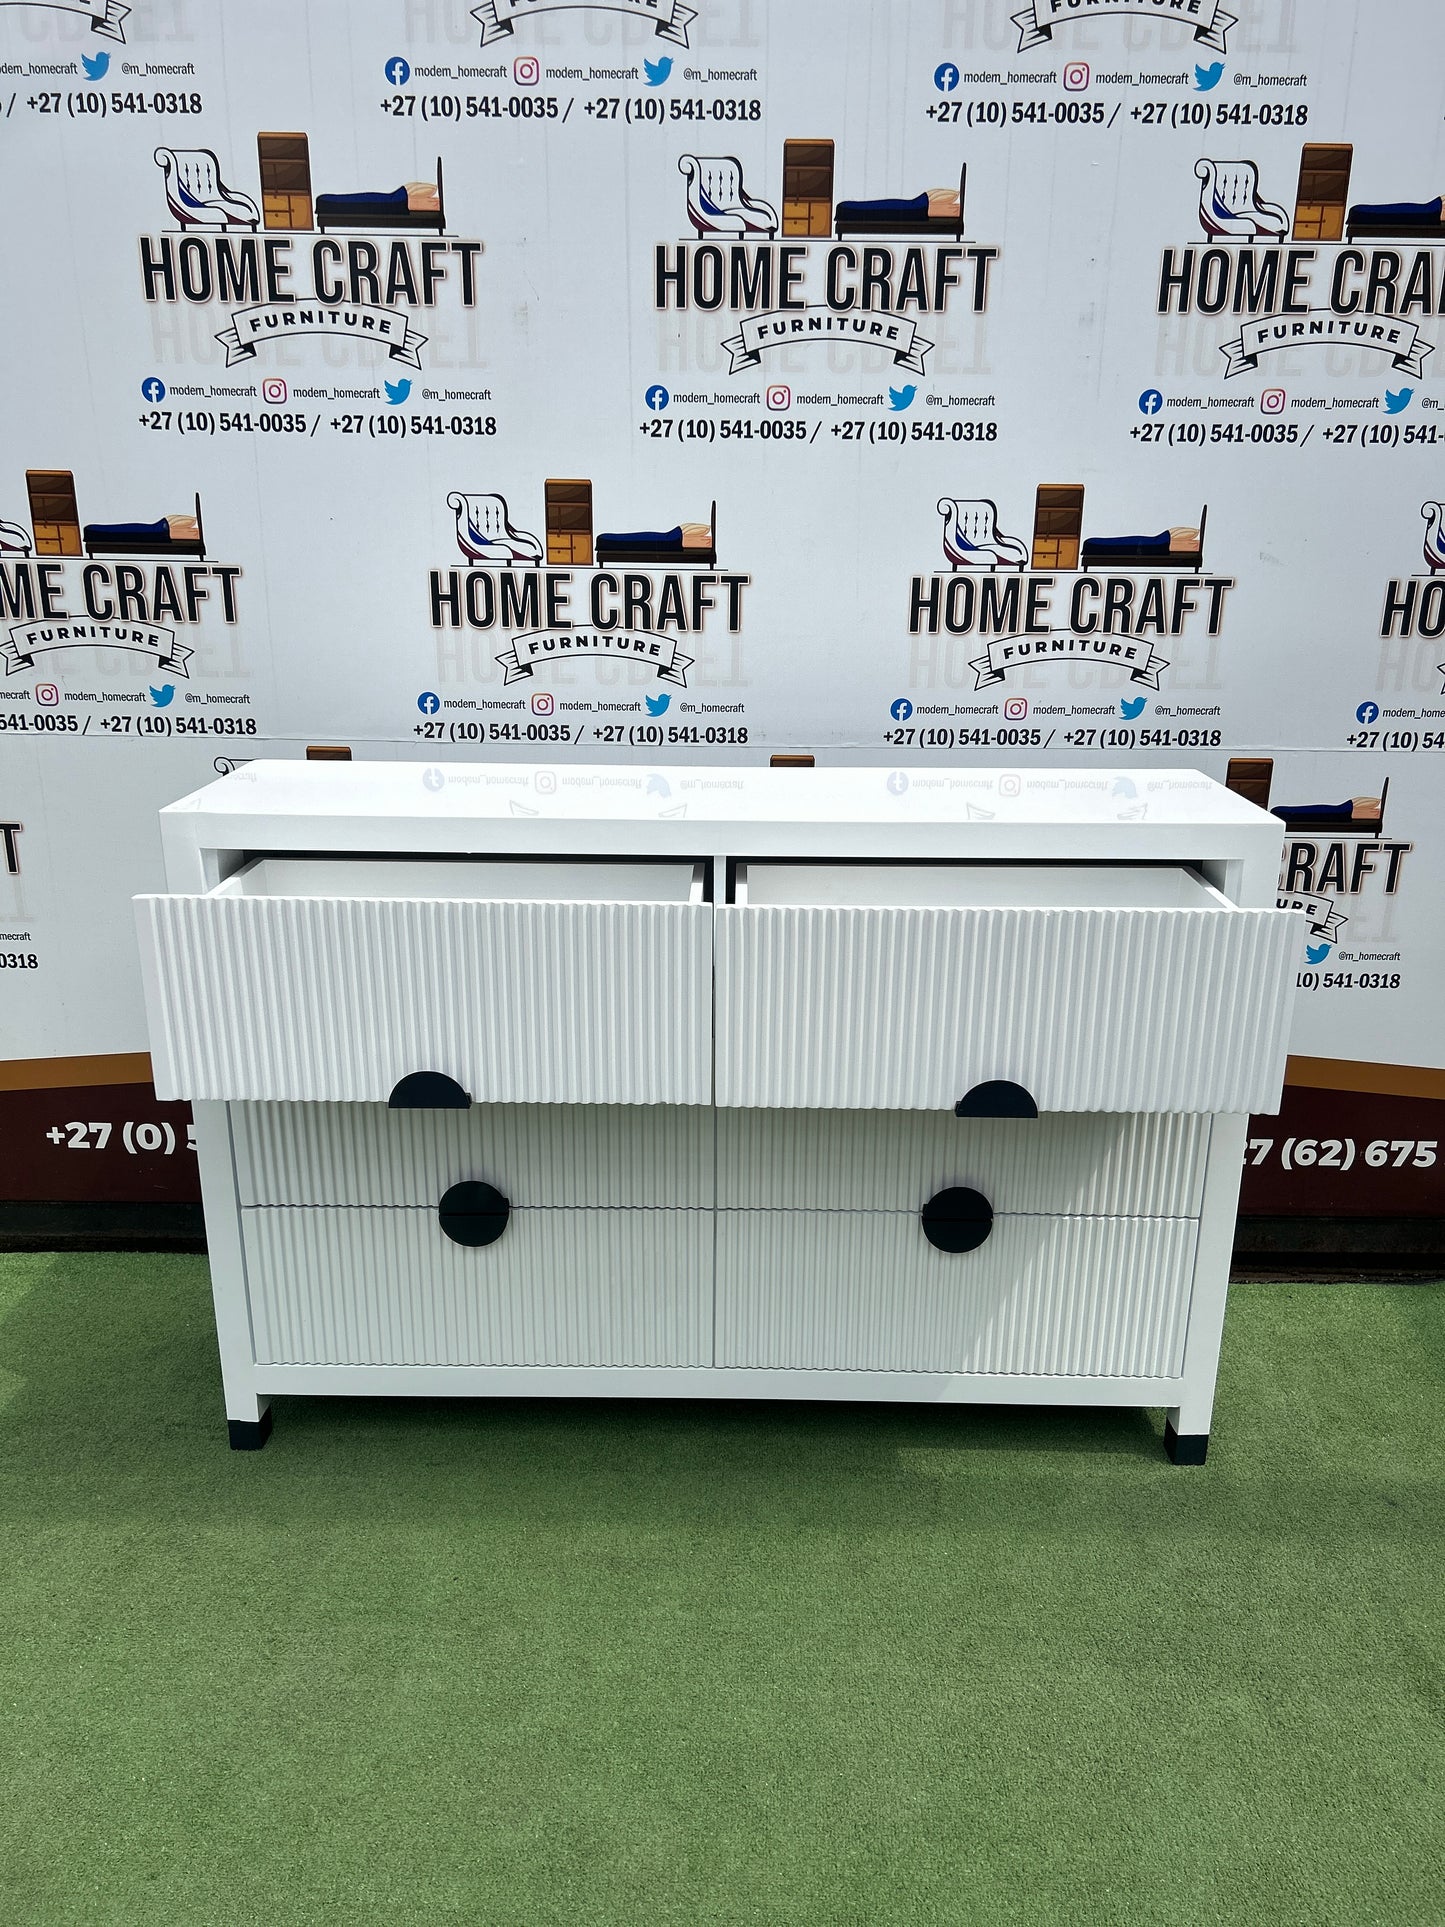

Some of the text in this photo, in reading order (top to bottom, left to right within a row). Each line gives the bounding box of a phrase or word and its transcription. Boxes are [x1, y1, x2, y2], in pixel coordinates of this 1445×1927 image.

[122, 63, 195, 76] @m_homecraft
[684, 68, 757, 82] @m_homecraft
[1234, 74, 1307, 87] @m_homecraft
[27, 93, 61, 112] +27
[68, 93, 106, 117] (10)
[112, 93, 202, 114] 541-0318
[381, 95, 415, 116] +27
[422, 96, 460, 121] (10)
[466, 96, 558, 118] 541-0035
[584, 98, 619, 119] +27
[626, 99, 664, 124] (10)
[670, 99, 761, 120] 541-0318
[926, 102, 962, 122] +27
[967, 102, 1006, 127] (10)
[1012, 102, 1104, 123] 541-0035
[1131, 103, 1167, 123] +27
[1172, 104, 1211, 129] (10)
[1216, 104, 1308, 125] 541-0318
[139, 236, 482, 306] HOME CRAFT
[655, 244, 997, 313] HOME CRAFT
[1157, 249, 1445, 316] HOME CRA
[250, 310, 393, 334] FURNITURE
[757, 316, 900, 340] FURNITURE
[1257, 320, 1402, 344] FURNITURE
[422, 389, 491, 401] @m_homecraft
[926, 395, 995, 407] @m_homecraft
[139, 412, 172, 430] +27
[178, 412, 215, 435] (10)
[220, 413, 306, 432] 541-0035
[331, 415, 363, 433] +27
[369, 416, 406, 438] (10)
[411, 416, 496, 435] 541-0318
[640, 419, 673, 437] +27
[678, 420, 715, 442] (10)
[720, 420, 806, 439] 541-0035
[831, 421, 865, 439] +27
[870, 422, 906, 444] (10)
[911, 422, 997, 441] 541-0318
[1130, 424, 1164, 441] +27
[1169, 424, 1205, 446] (10)
[1210, 424, 1298, 443] 541-0035
[1323, 425, 1358, 443] +27
[1361, 425, 1399, 447] (10)
[1403, 425, 1445, 443] 541-
[83, 564, 241, 623] CRAFT
[430, 571, 749, 632] HOME CRAFT
[909, 577, 1234, 636] HOME CRAFT
[26, 625, 160, 647] FURNITURE
[528, 634, 662, 656] FURNITURE
[1003, 639, 1138, 660] FURNITURE
[185, 693, 250, 704] @m_homecraft
[680, 703, 744, 714] @m_homecraft
[1155, 706, 1220, 716] @m_homecraft
[101, 716, 131, 732] +27
[137, 717, 171, 737] (10)
[176, 717, 256, 734] 541-0318
[414, 722, 444, 738] +27
[450, 723, 484, 743] (10)
[489, 724, 570, 741] 541-0035
[593, 726, 624, 741] +27
[629, 726, 663, 746] (10)
[668, 727, 748, 743] 541-0318
[884, 729, 915, 744] +27
[920, 729, 954, 748] (10)
[959, 729, 1040, 745] 541-0035
[1064, 729, 1096, 745] +27
[1100, 729, 1135, 749] (10)
[1140, 730, 1221, 747] 541-0318
[1347, 732, 1444, 752] +27 (10) 54
[1279, 842, 1411, 892] RAFT
[1339, 952, 1400, 961] @m_homecraft
[1323, 973, 1400, 988] 541-0318
[46, 1122, 112, 1149] +27
[122, 1121, 176, 1154] (0)
[1243, 1137, 1438, 1170] 7 (62) 675
